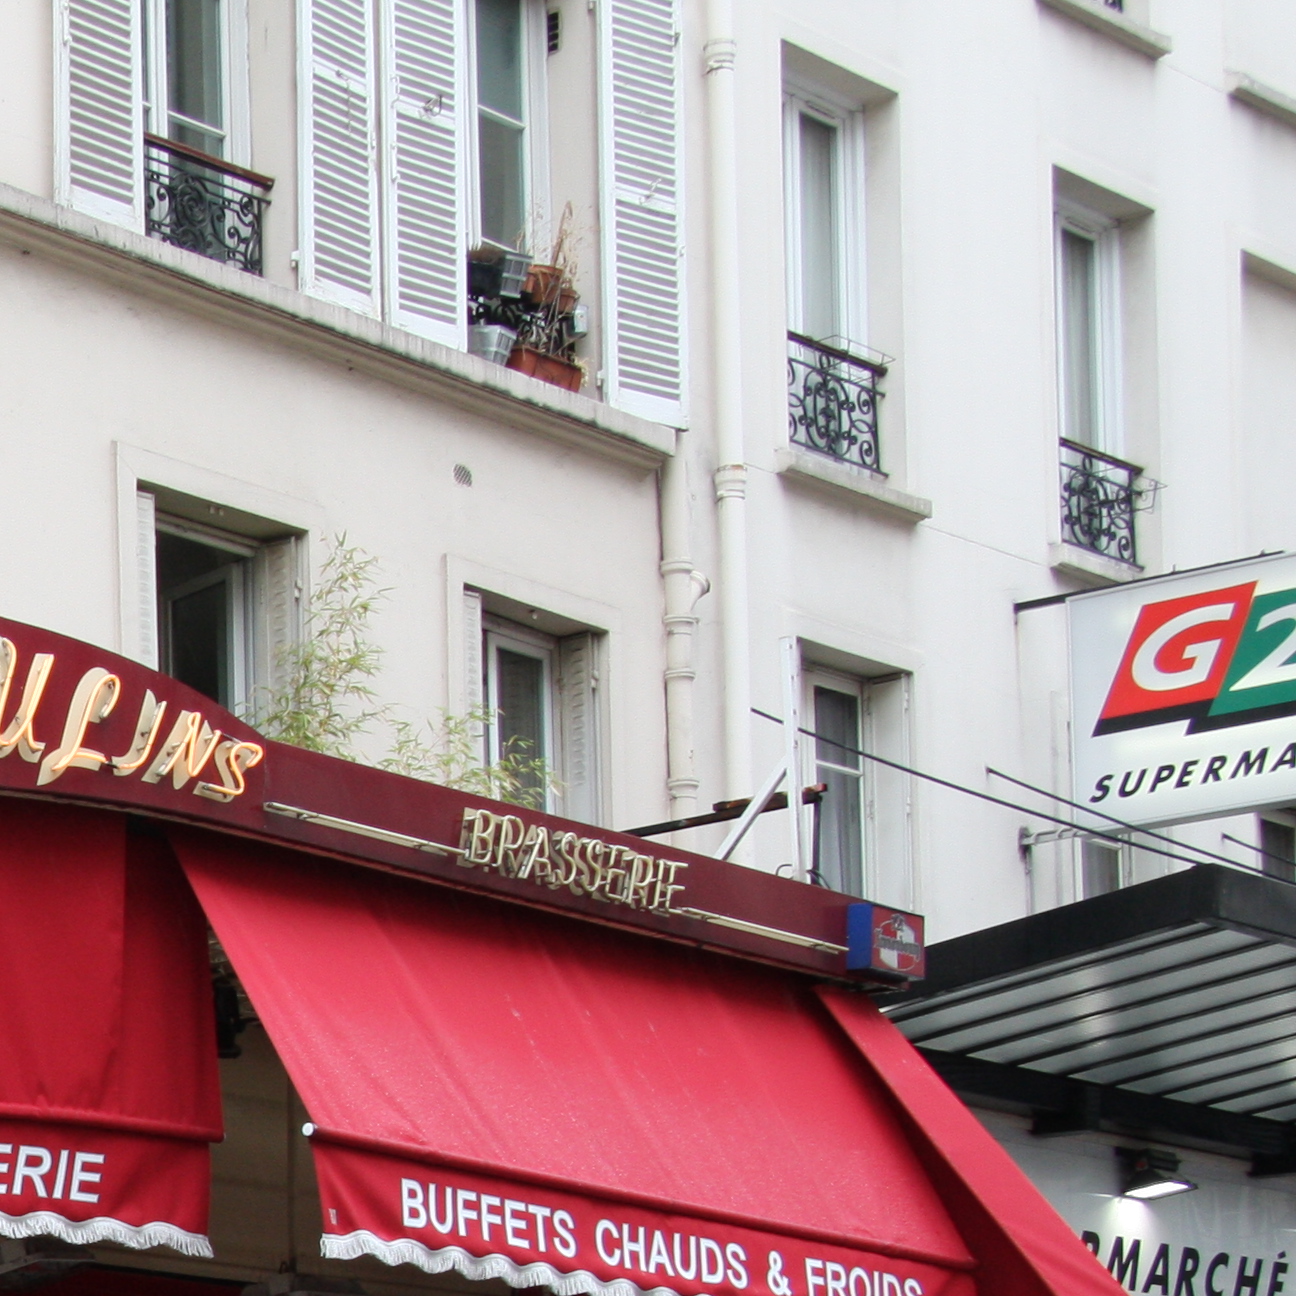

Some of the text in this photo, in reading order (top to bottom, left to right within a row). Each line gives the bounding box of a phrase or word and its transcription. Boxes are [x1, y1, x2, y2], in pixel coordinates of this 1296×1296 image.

[1089, 742, 1296, 803] SUPERMA
[457, 807, 688, 917] BRASSERIE
[400, 1177, 578, 1259] BUFFETS
[595, 1220, 749, 1290] CHAUDS
